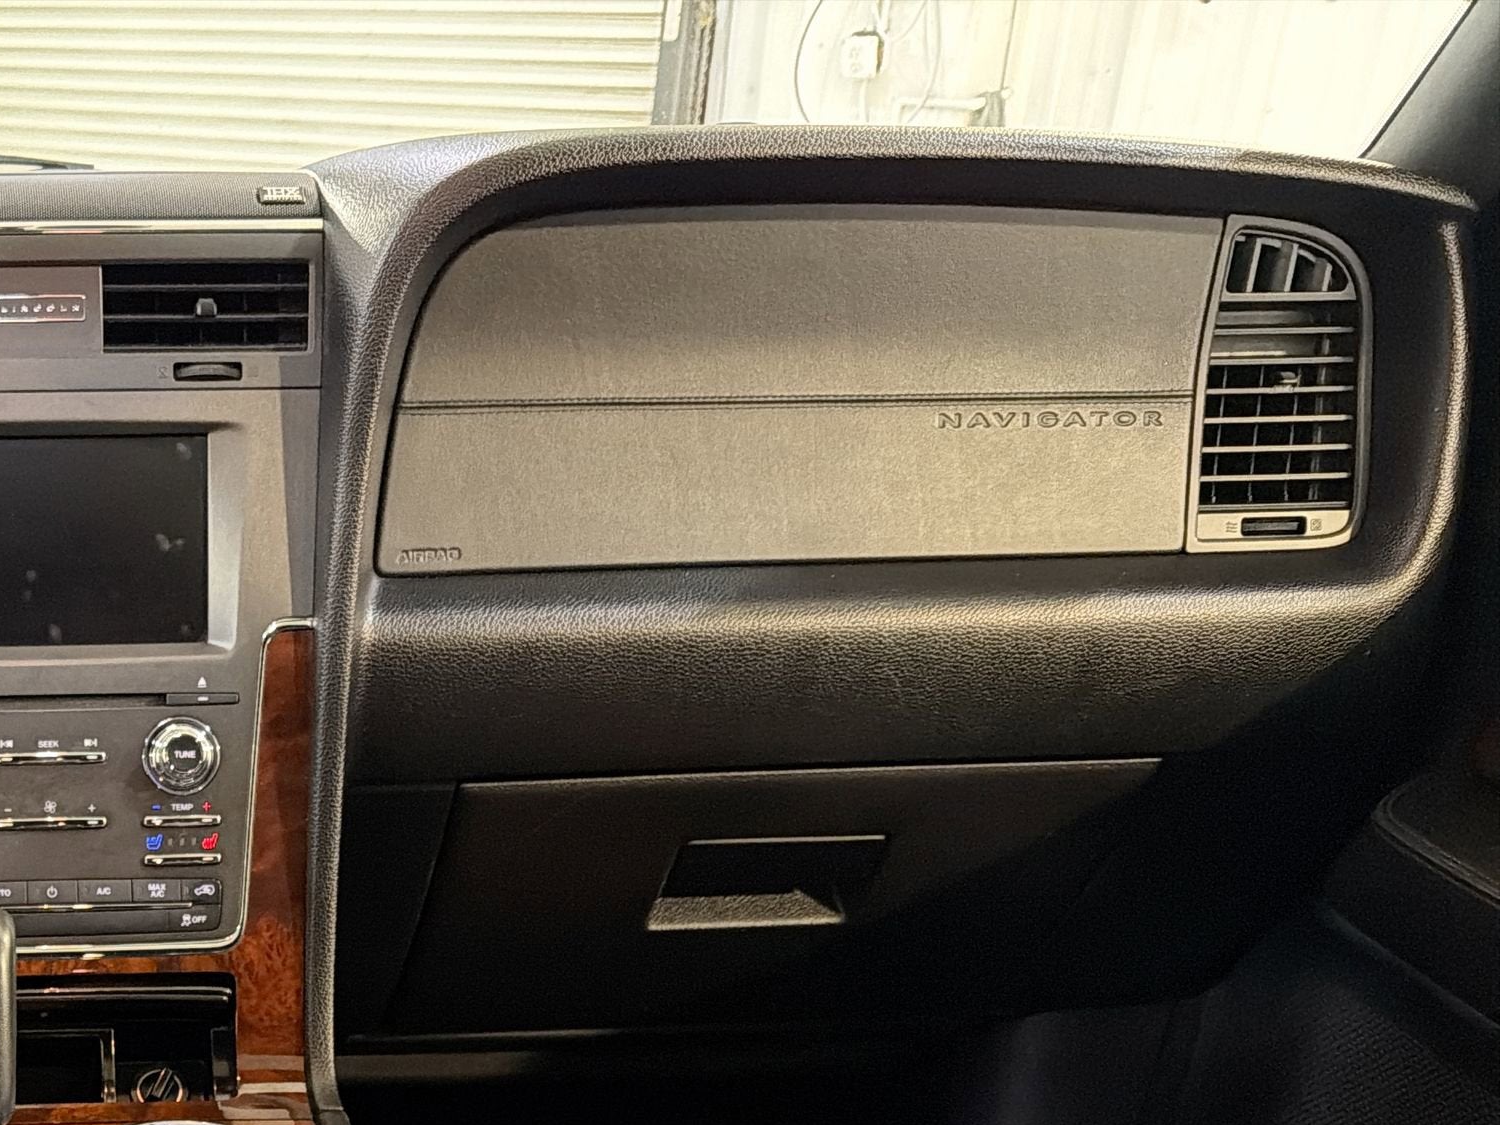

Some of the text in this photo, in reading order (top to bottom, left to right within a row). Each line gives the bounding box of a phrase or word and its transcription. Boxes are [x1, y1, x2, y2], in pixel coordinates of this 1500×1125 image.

[937, 410, 1164, 429] NAVIGATOR
[396, 546, 462, 564] AIRBAG
[37, 740, 59, 748] SEEK
[173, 750, 197, 759] TUNE
[170, 803, 194, 811] TEMP
[96, 887, 112, 895] A/C
[147, 883, 167, 891] MAX
[150, 890, 165, 898] A/C
[191, 915, 207, 923] OFF
